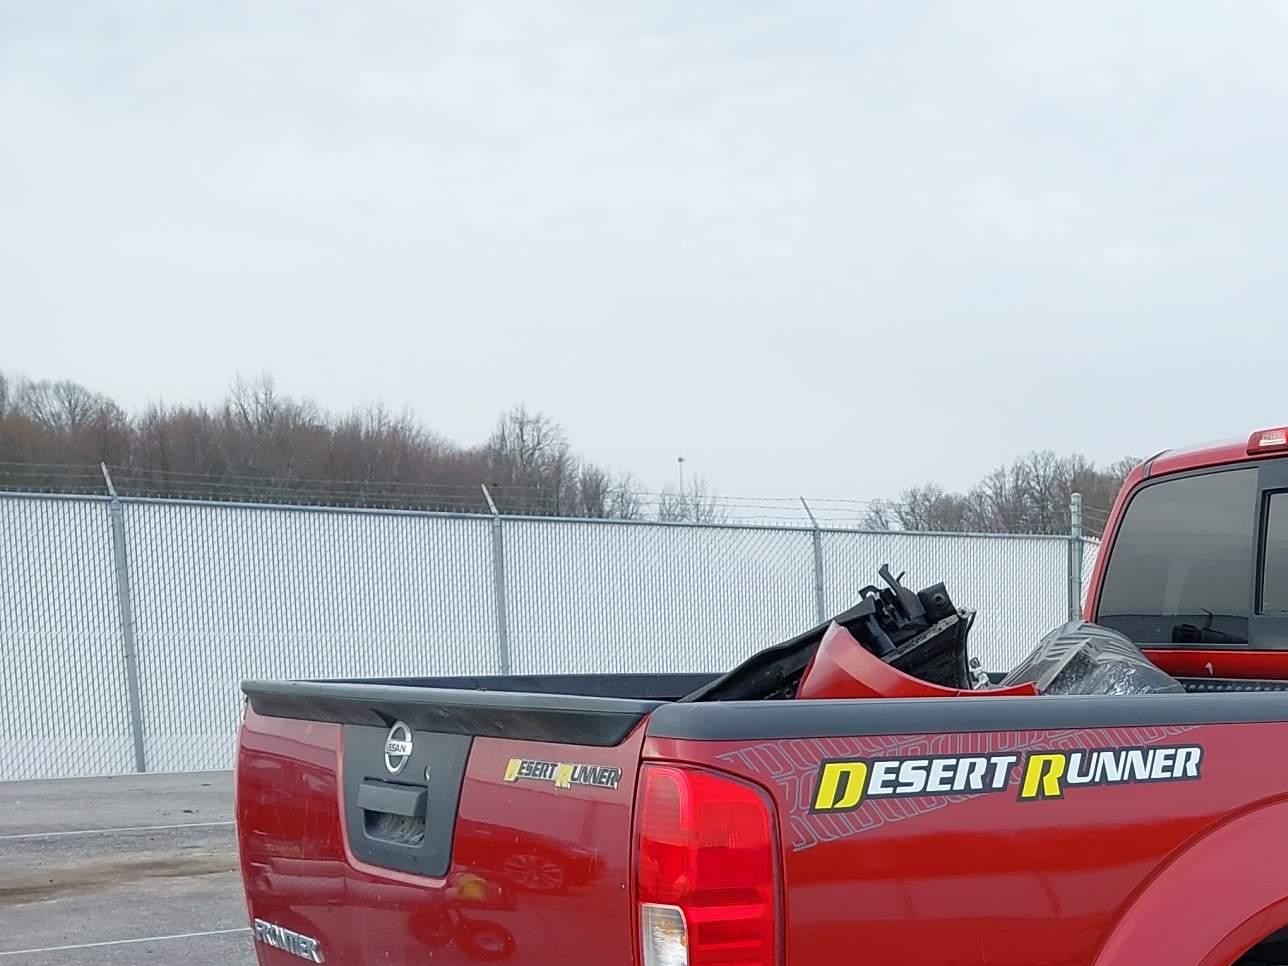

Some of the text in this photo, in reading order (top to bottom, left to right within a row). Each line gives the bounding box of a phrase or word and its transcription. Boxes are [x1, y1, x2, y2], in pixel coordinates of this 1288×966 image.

[504, 757, 622, 790] DESERT RUNNER
[813, 746, 1202, 811] DESERT RUNNER
[254, 918, 325, 964] FRONTIER
